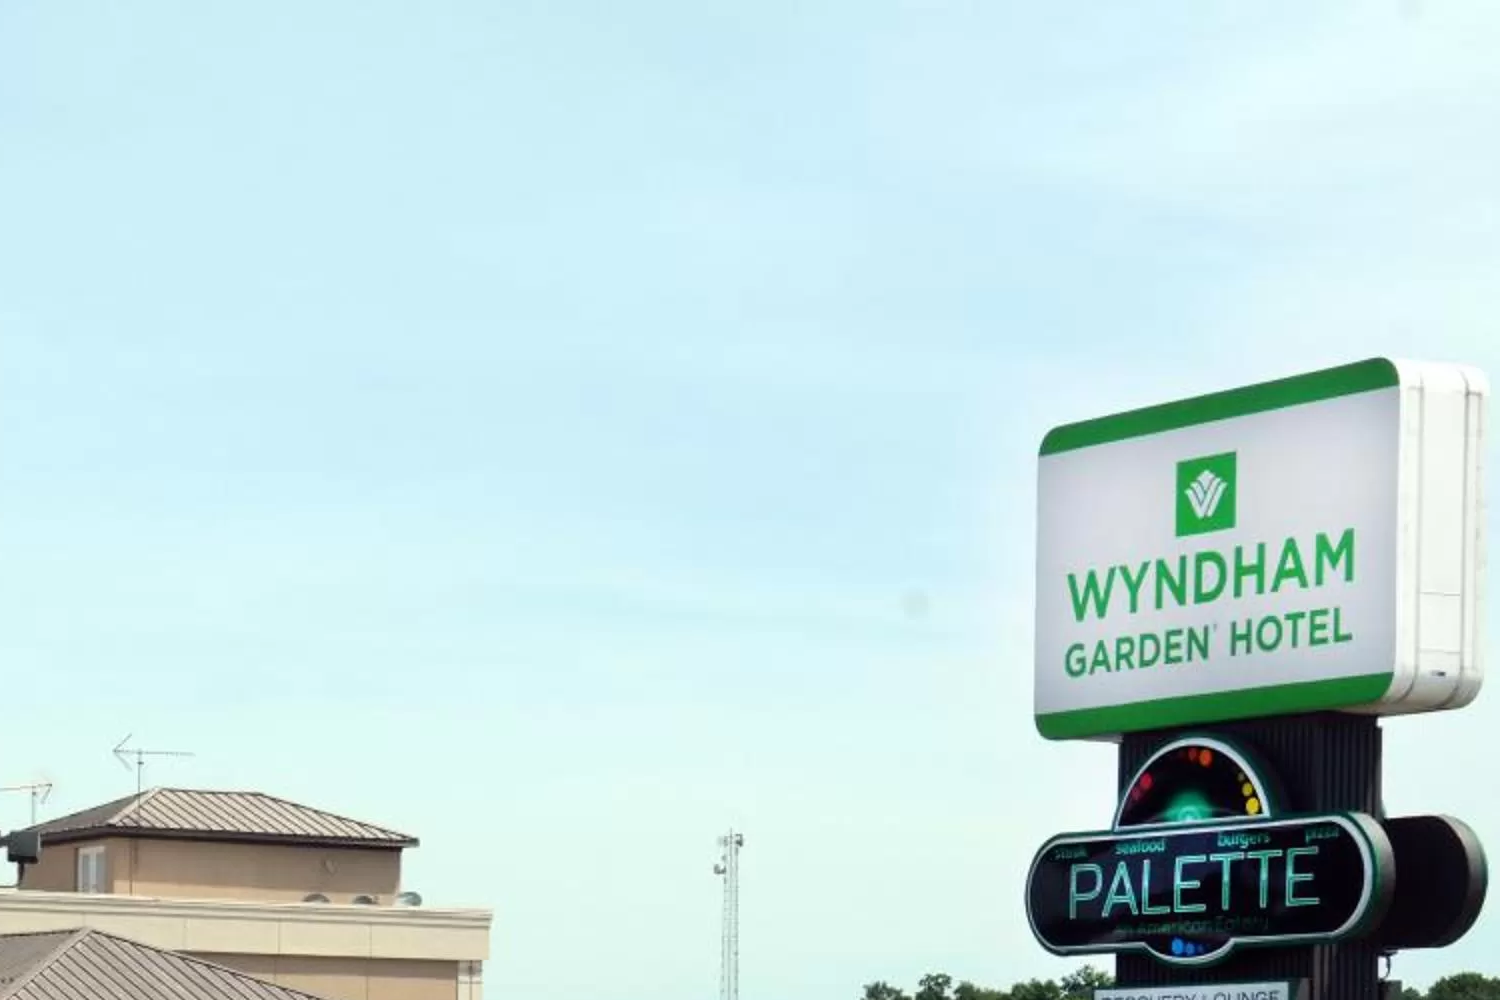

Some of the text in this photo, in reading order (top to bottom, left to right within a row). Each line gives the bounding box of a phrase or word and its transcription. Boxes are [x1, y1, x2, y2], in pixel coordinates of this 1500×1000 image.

[1068, 528, 1355, 621] WYNDHAM
[1230, 607, 1353, 656] HOTEL
[1069, 845, 1320, 920] PALETTE
